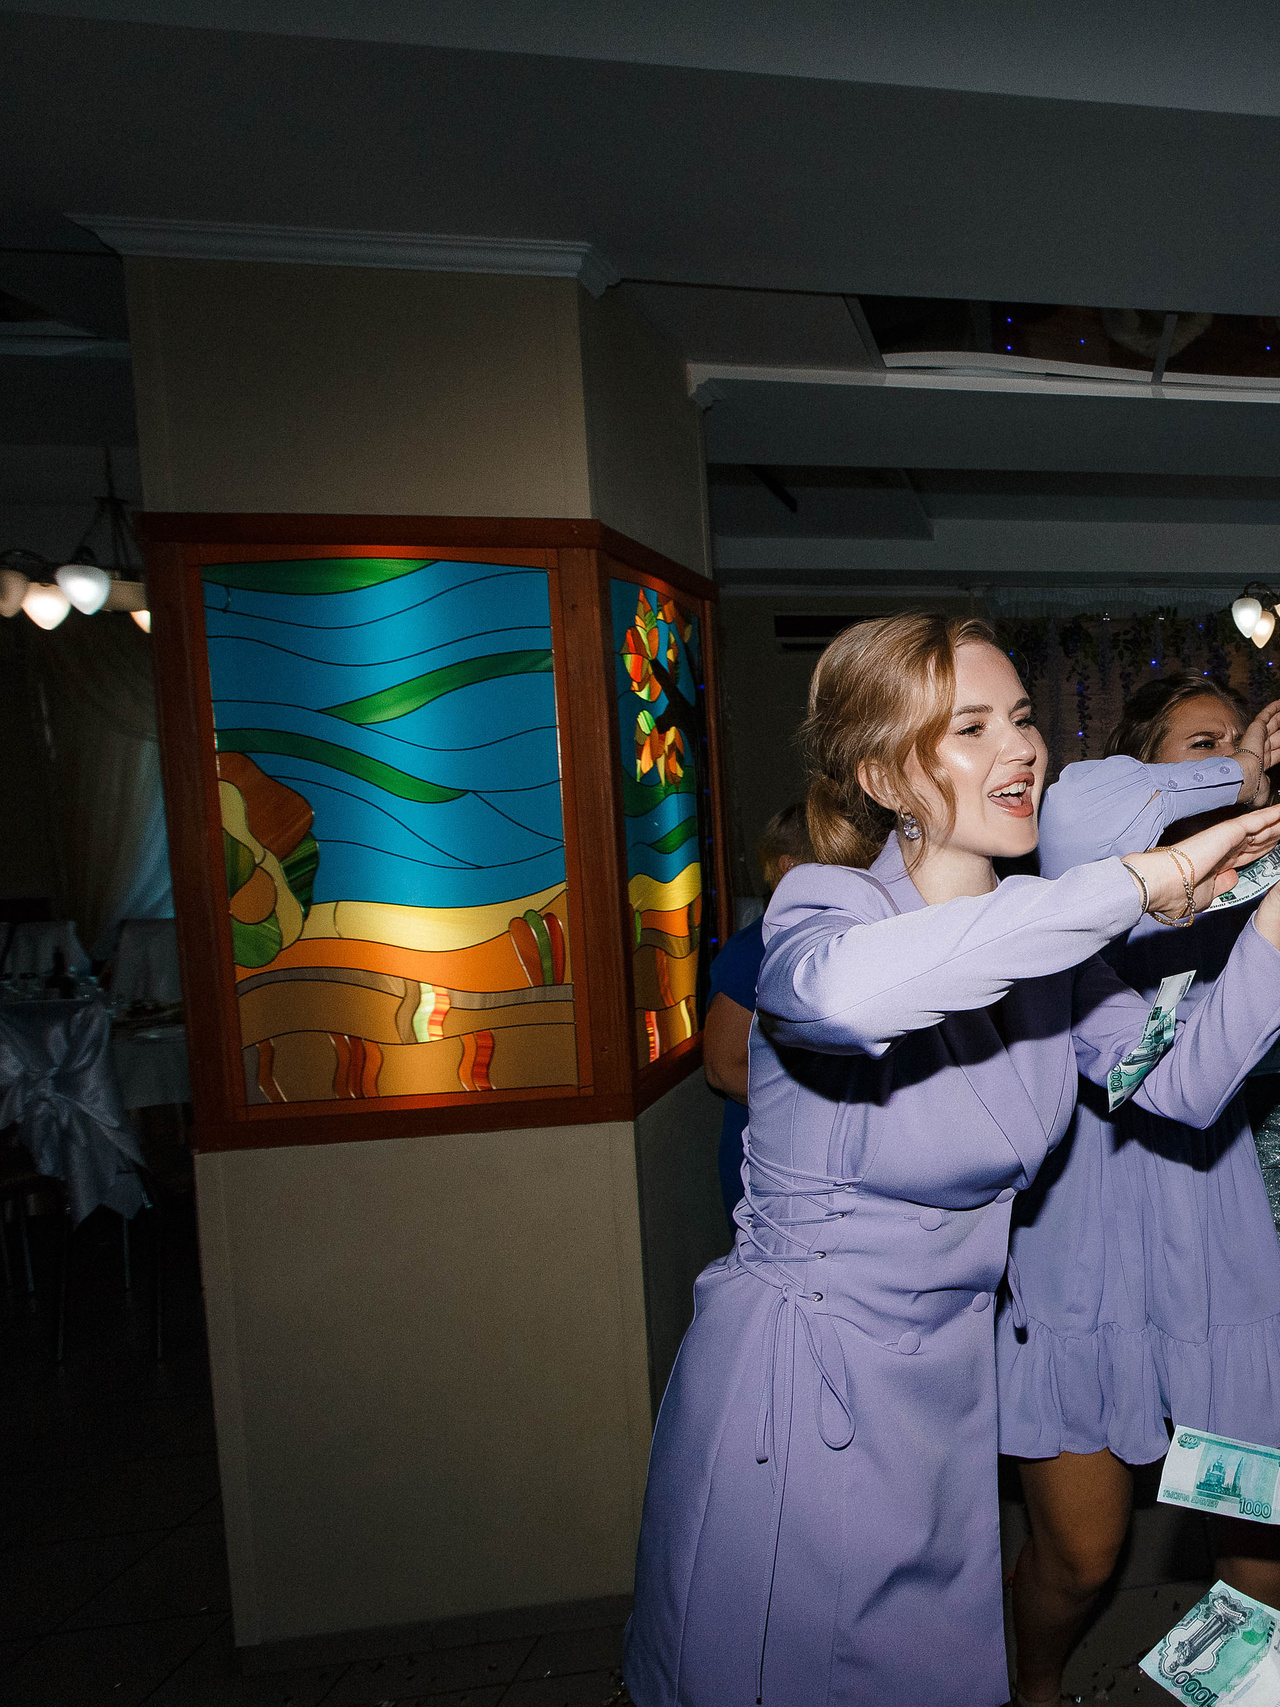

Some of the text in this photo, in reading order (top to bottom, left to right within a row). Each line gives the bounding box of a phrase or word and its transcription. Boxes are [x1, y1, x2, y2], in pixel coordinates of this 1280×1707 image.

[1181, 1434, 1198, 1444] 1000
[1239, 1498, 1272, 1519] 1000
[1171, 1671, 1219, 1707] 1000
